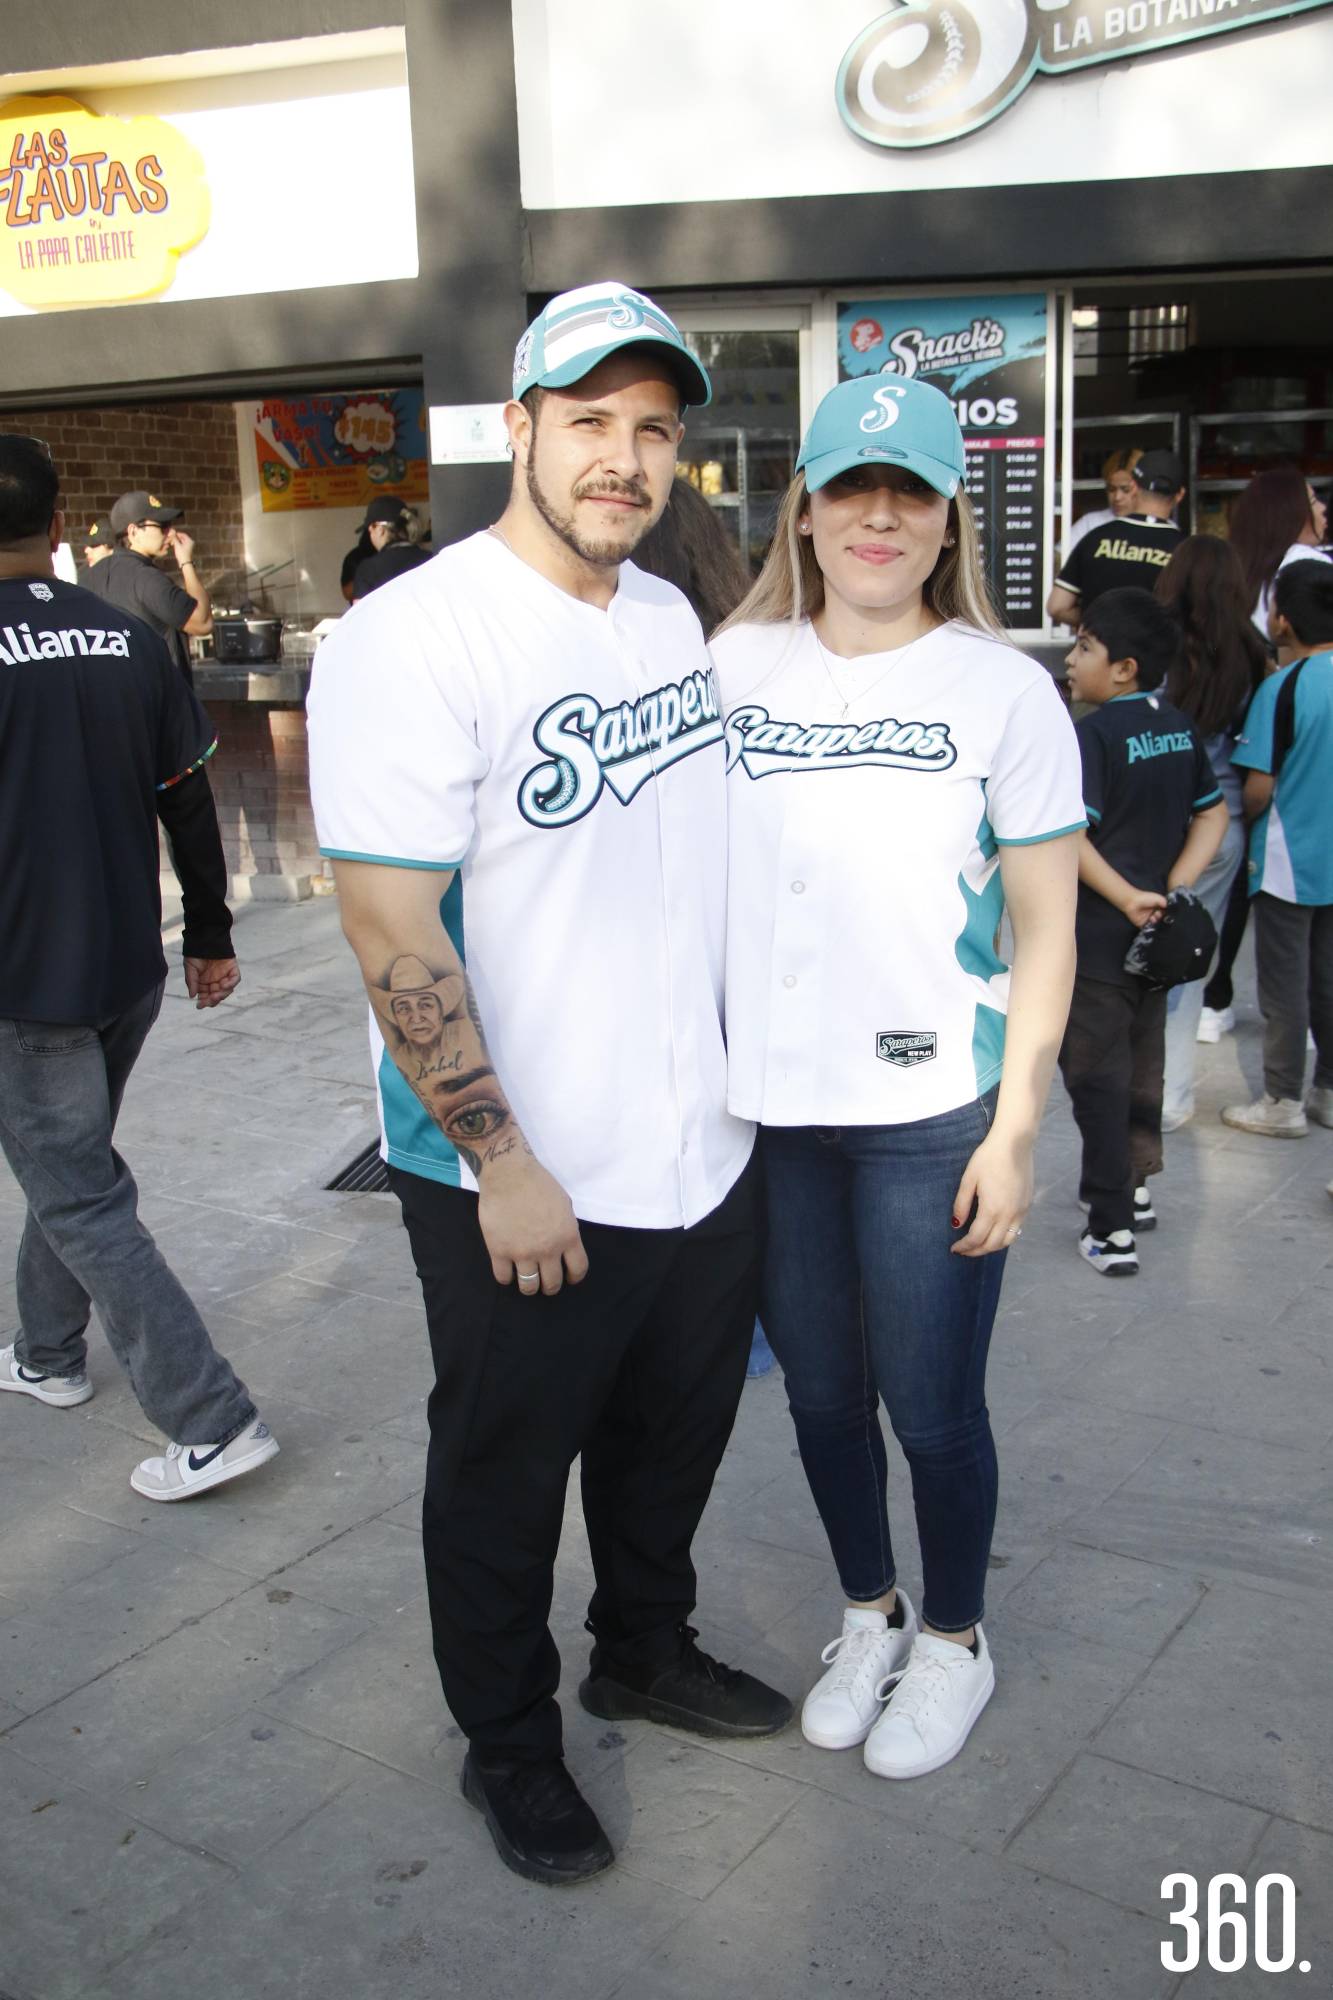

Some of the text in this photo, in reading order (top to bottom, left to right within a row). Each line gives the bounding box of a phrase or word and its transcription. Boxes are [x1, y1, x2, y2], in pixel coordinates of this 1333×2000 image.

[1053, 16, 1093, 52] LA
[11, 129, 67, 168] LAS
[18, 230, 136, 269] LA PAPA CALIENTE
[880, 319, 1005, 379] Snack's
[920, 361, 931, 371] LA
[859, 386, 906, 433] S
[517, 667, 722, 829] Saraper
